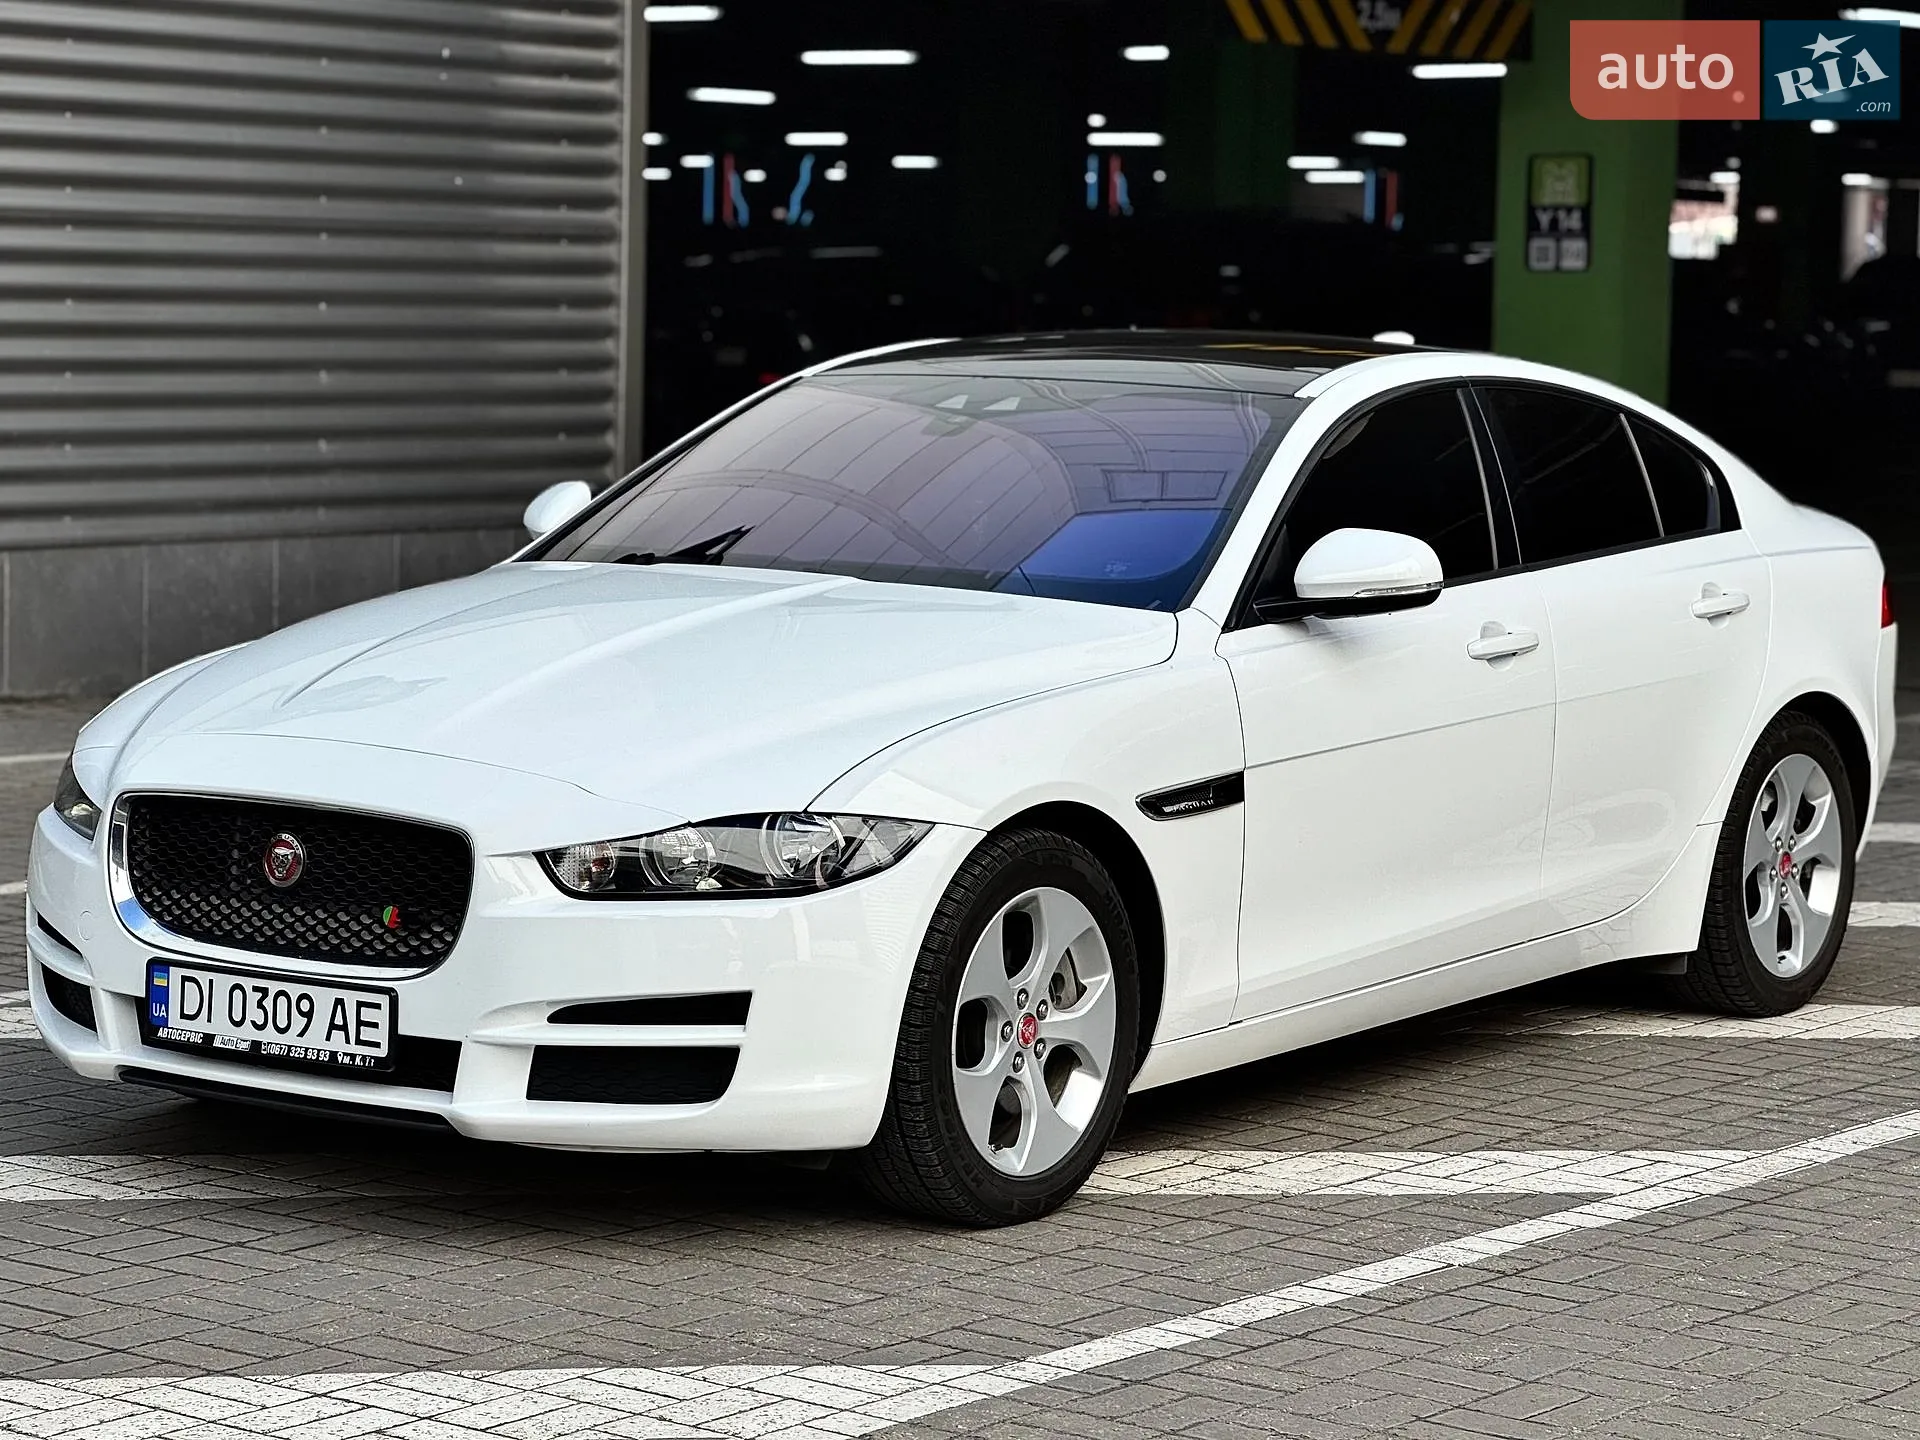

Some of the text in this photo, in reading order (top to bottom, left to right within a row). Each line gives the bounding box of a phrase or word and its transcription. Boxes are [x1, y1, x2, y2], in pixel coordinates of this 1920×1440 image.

[152, 1002, 167, 1018] UA
[180, 974, 382, 1049] DI 0309 AE
[267, 1043, 330, 1061] (067) 325 93 93
